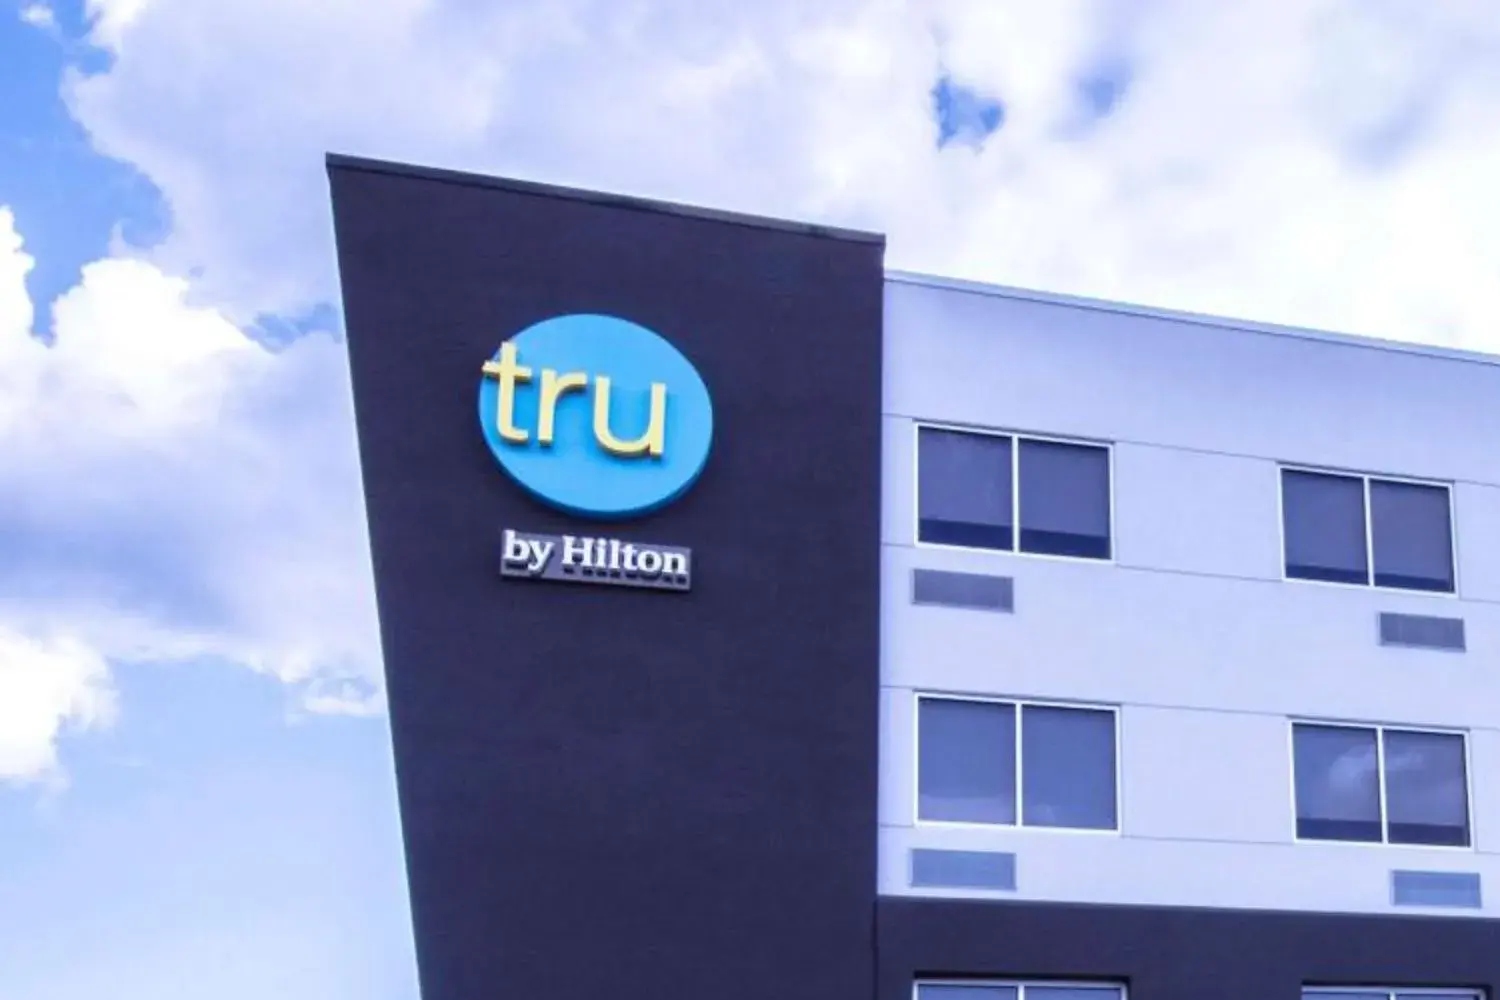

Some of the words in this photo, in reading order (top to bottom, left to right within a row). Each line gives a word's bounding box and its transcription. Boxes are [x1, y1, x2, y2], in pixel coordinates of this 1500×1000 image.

[481, 341, 667, 458] tru
[503, 529, 554, 570] by
[561, 535, 689, 576] Hilton
